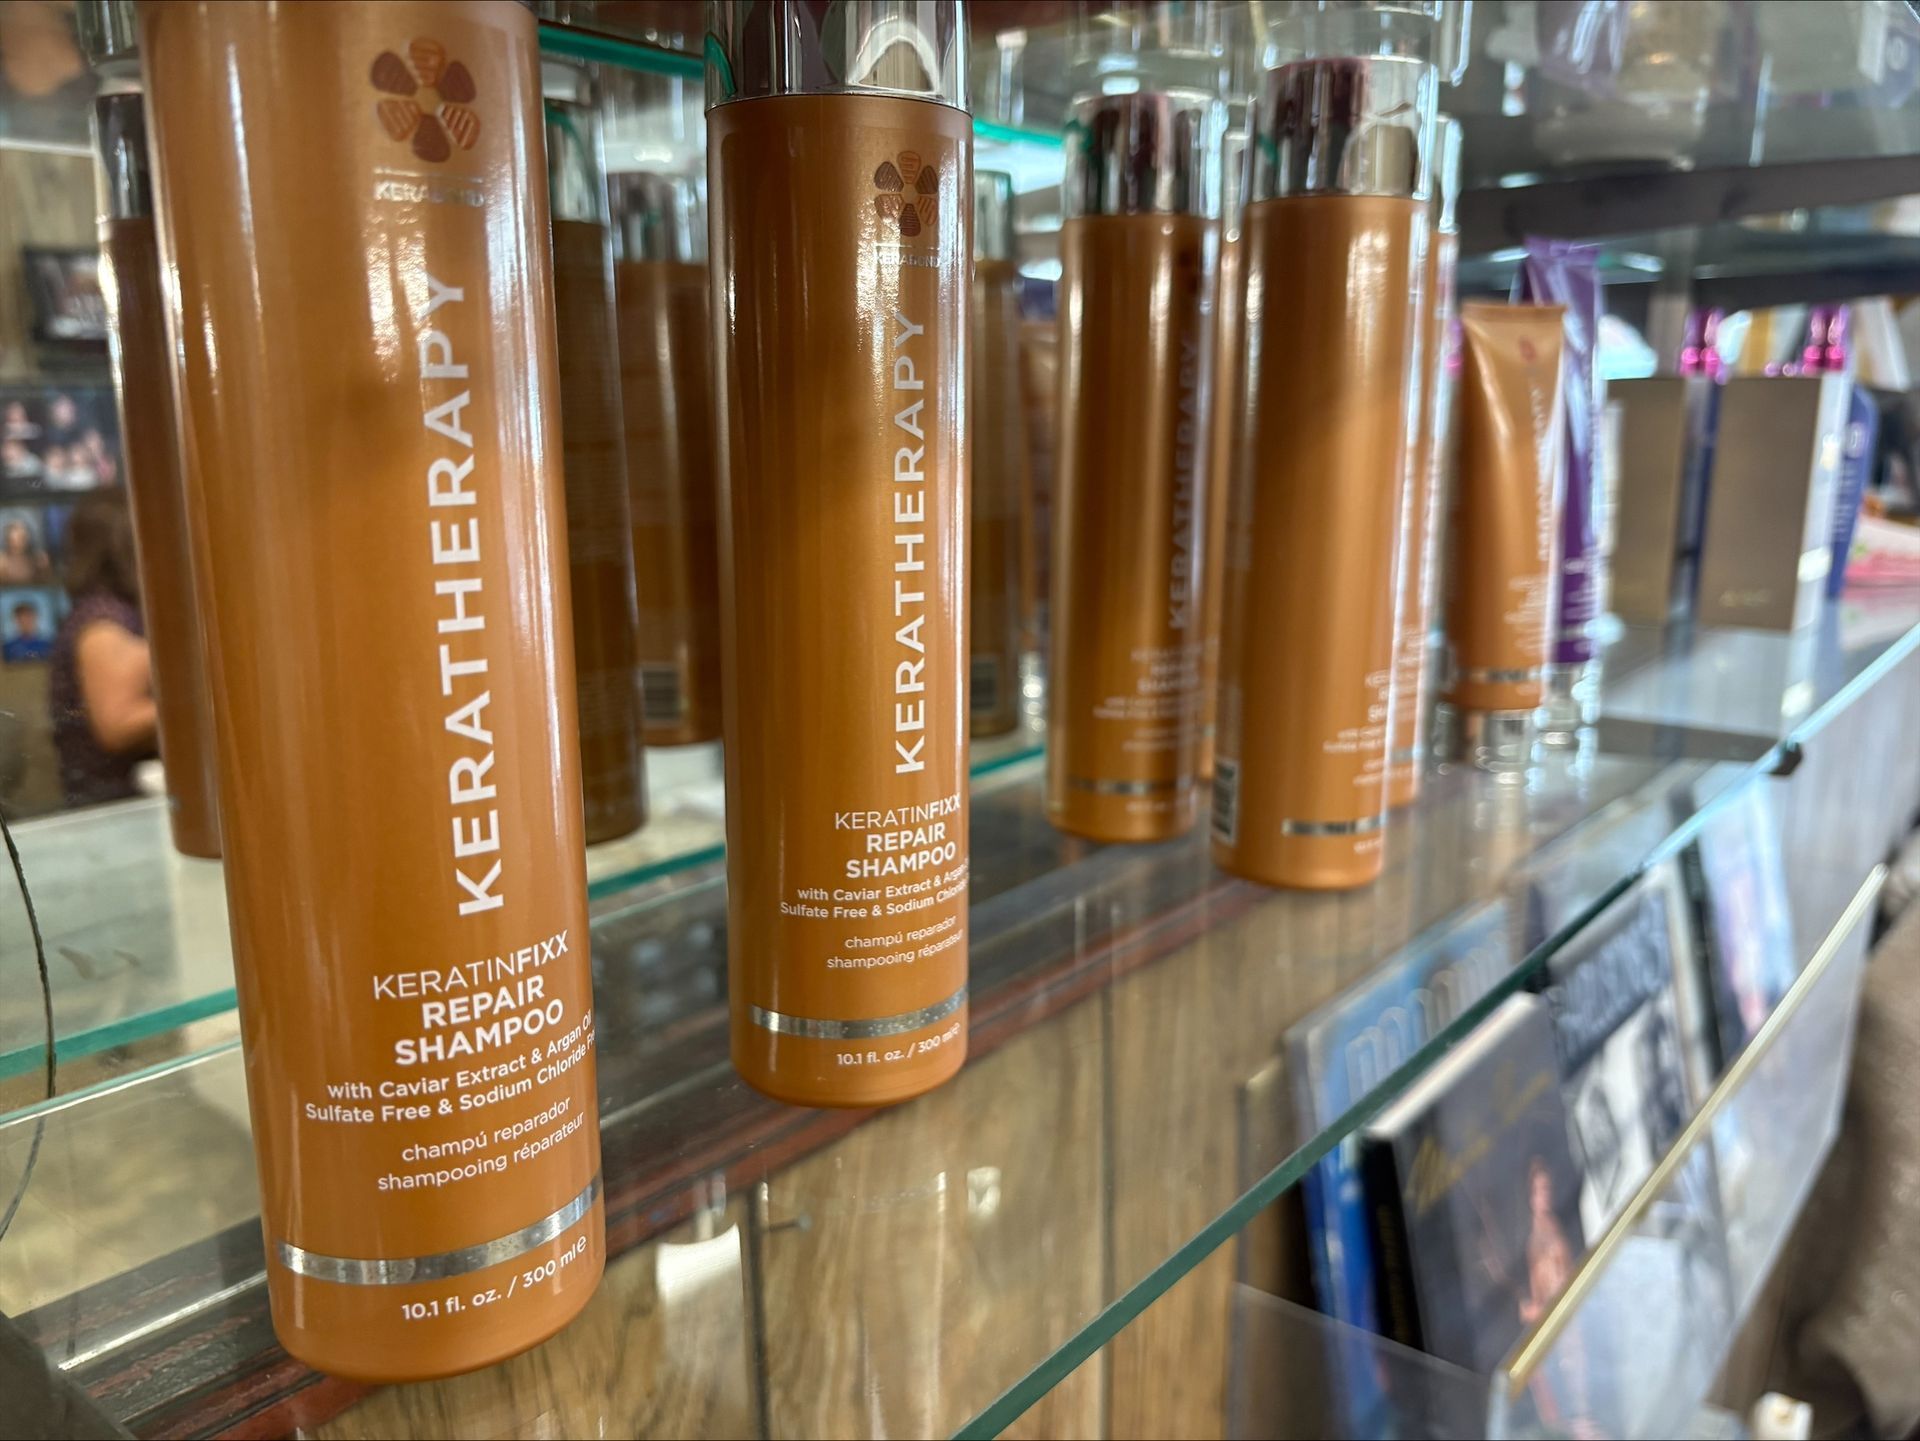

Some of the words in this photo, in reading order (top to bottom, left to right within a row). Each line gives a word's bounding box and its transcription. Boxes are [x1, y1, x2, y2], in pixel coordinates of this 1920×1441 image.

[894, 309, 926, 774] KERATHERAPY
[417, 269, 504, 916] KERATHERAPY
[835, 792, 961, 830] KERATINFIXX
[867, 821, 946, 853] REPAIR
[797, 888, 829, 901] with
[832, 887, 880, 901] Caviar
[885, 879, 931, 898] Extract
[933, 874, 942, 888] &
[846, 841, 956, 879] SHAMPOO
[780, 901, 829, 918] Sulfate
[833, 905, 867, 918] Free
[871, 904, 882, 917] &
[886, 896, 935, 915] Sodium
[844, 930, 902, 949] champú
[906, 914, 956, 942] reparador
[372, 929, 569, 1000] KERATINFIXX
[826, 949, 915, 969] shampooing
[422, 974, 545, 1029] REPAIR
[394, 998, 564, 1066] SHAMPOO
[836, 1052, 862, 1065] 10.1
[866, 1051, 880, 1063] fl.
[884, 1049, 905, 1061] oz.
[906, 1042, 916, 1058] /
[918, 1035, 940, 1053] 300
[305, 1102, 374, 1122] Sulfate
[381, 1104, 432, 1122] Free
[437, 1097, 454, 1116] &
[459, 1077, 533, 1111] Sodium
[536, 1043, 587, 1085] Chloride
[327, 1081, 373, 1100] with
[379, 1077, 450, 1098] Caviar
[456, 1054, 527, 1089] Extract
[530, 1047, 543, 1065] &
[547, 1025, 582, 1058] Argan
[377, 1153, 508, 1191] shampooing
[513, 1111, 584, 1163] réparateur
[401, 1130, 488, 1162] champú
[493, 1096, 571, 1143] reparador
[402, 1301, 438, 1320] 10.1
[445, 1295, 467, 1314] fl.
[471, 1289, 502, 1307] oz.
[506, 1275, 518, 1299] /
[522, 1260, 557, 1288] 300
